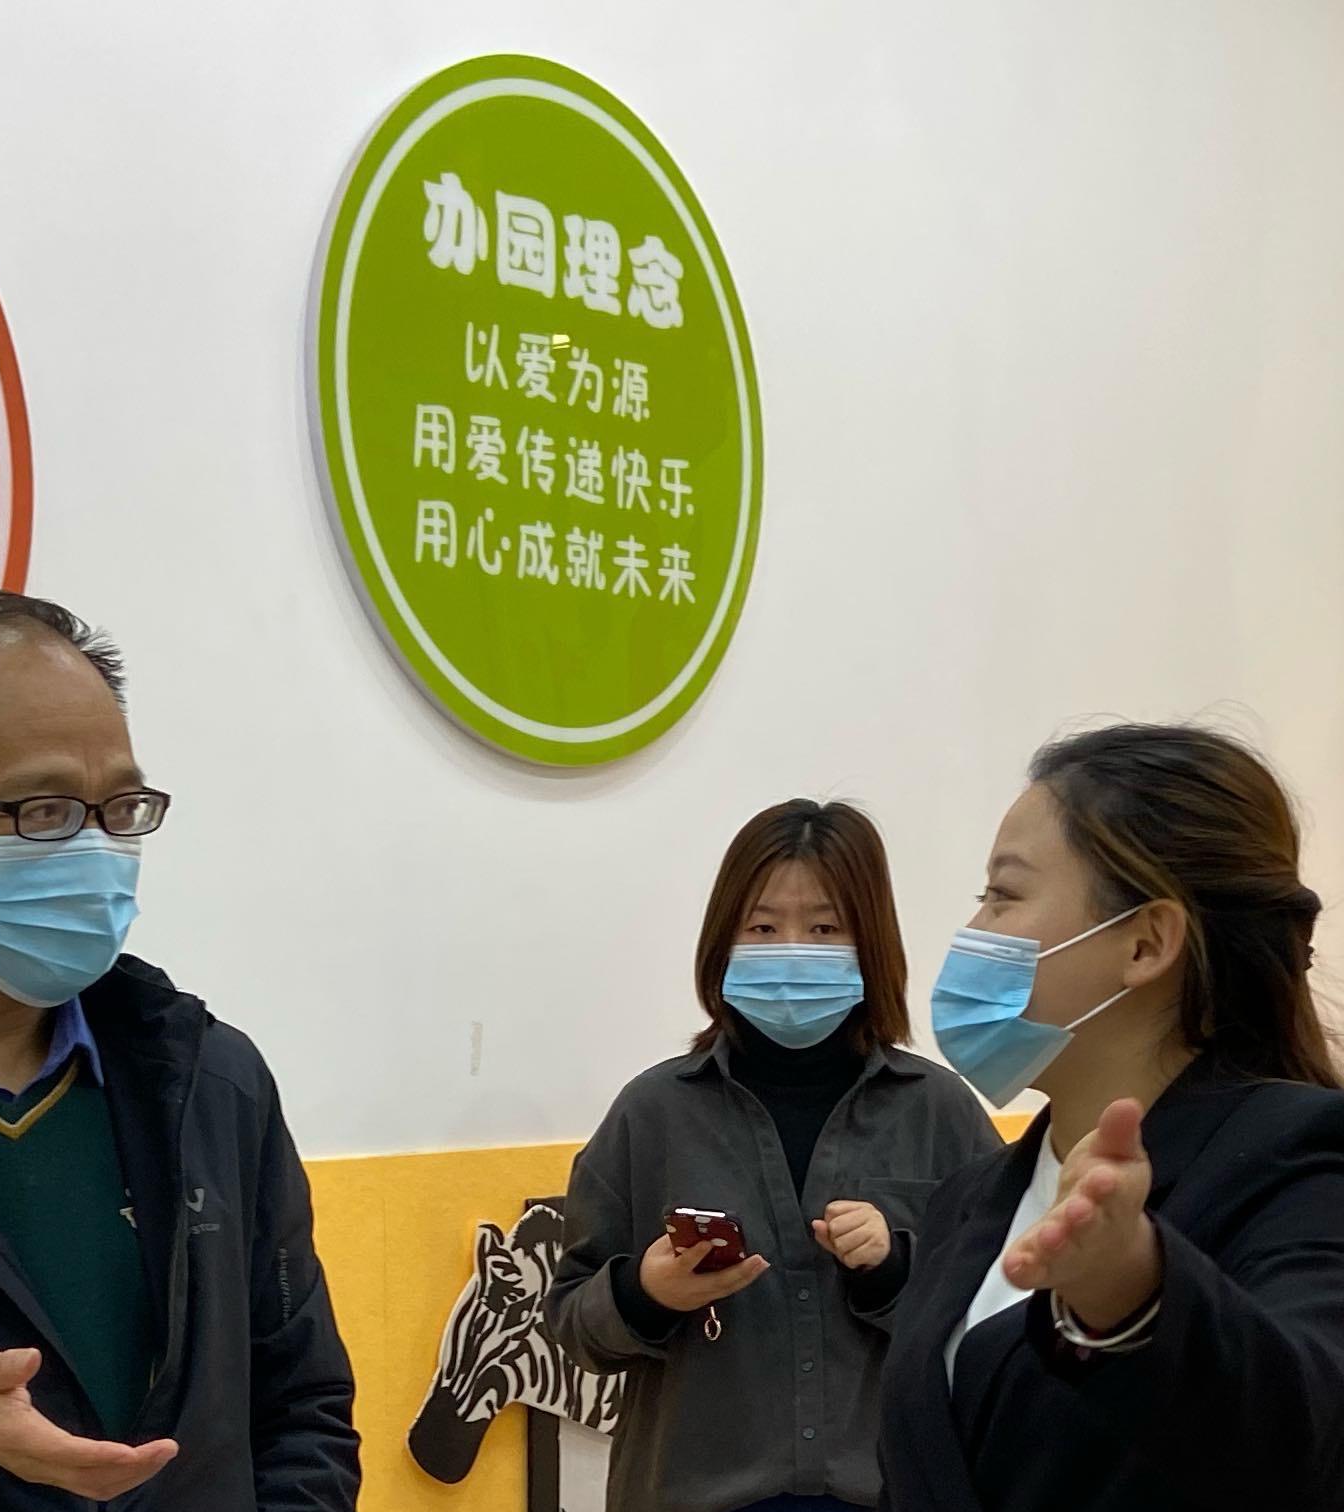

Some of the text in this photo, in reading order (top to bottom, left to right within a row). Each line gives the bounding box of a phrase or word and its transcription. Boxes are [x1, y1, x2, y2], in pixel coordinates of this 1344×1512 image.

[423, 172, 685, 330] 办园理念
[465, 322, 651, 422] 以爱为源
[414, 404, 694, 517] 用爱传递快乐
[414, 499, 695, 605] 用心成就未来
